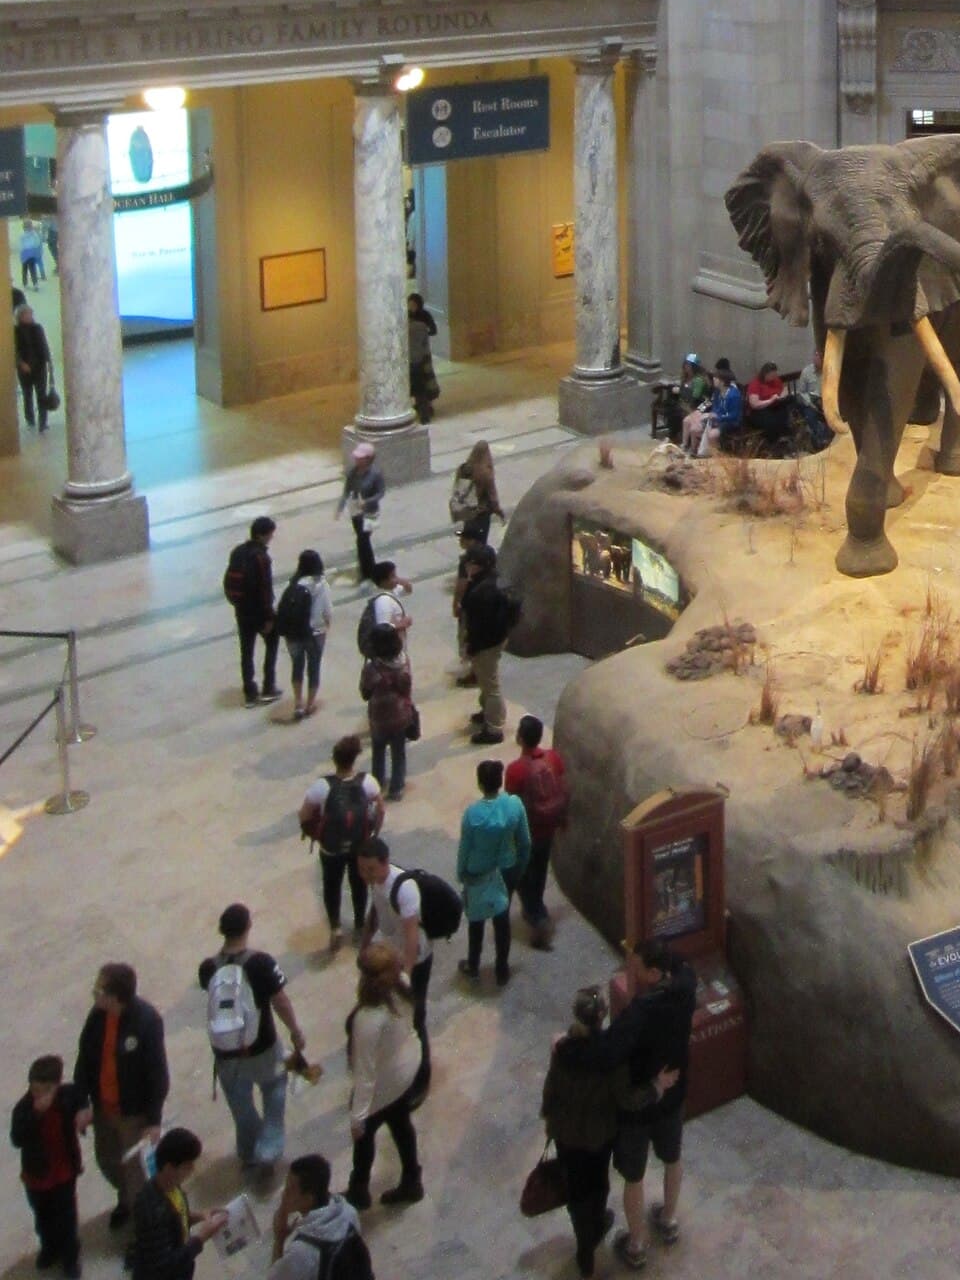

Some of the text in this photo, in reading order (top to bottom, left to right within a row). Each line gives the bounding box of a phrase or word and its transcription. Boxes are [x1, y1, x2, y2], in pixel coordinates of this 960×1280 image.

[276, 18, 365, 44] FAMILY
[377, 9, 493, 36] ROTUNDA
[472, 97, 539, 114] Rest Rooms
[473, 124, 527, 140] Escalator
